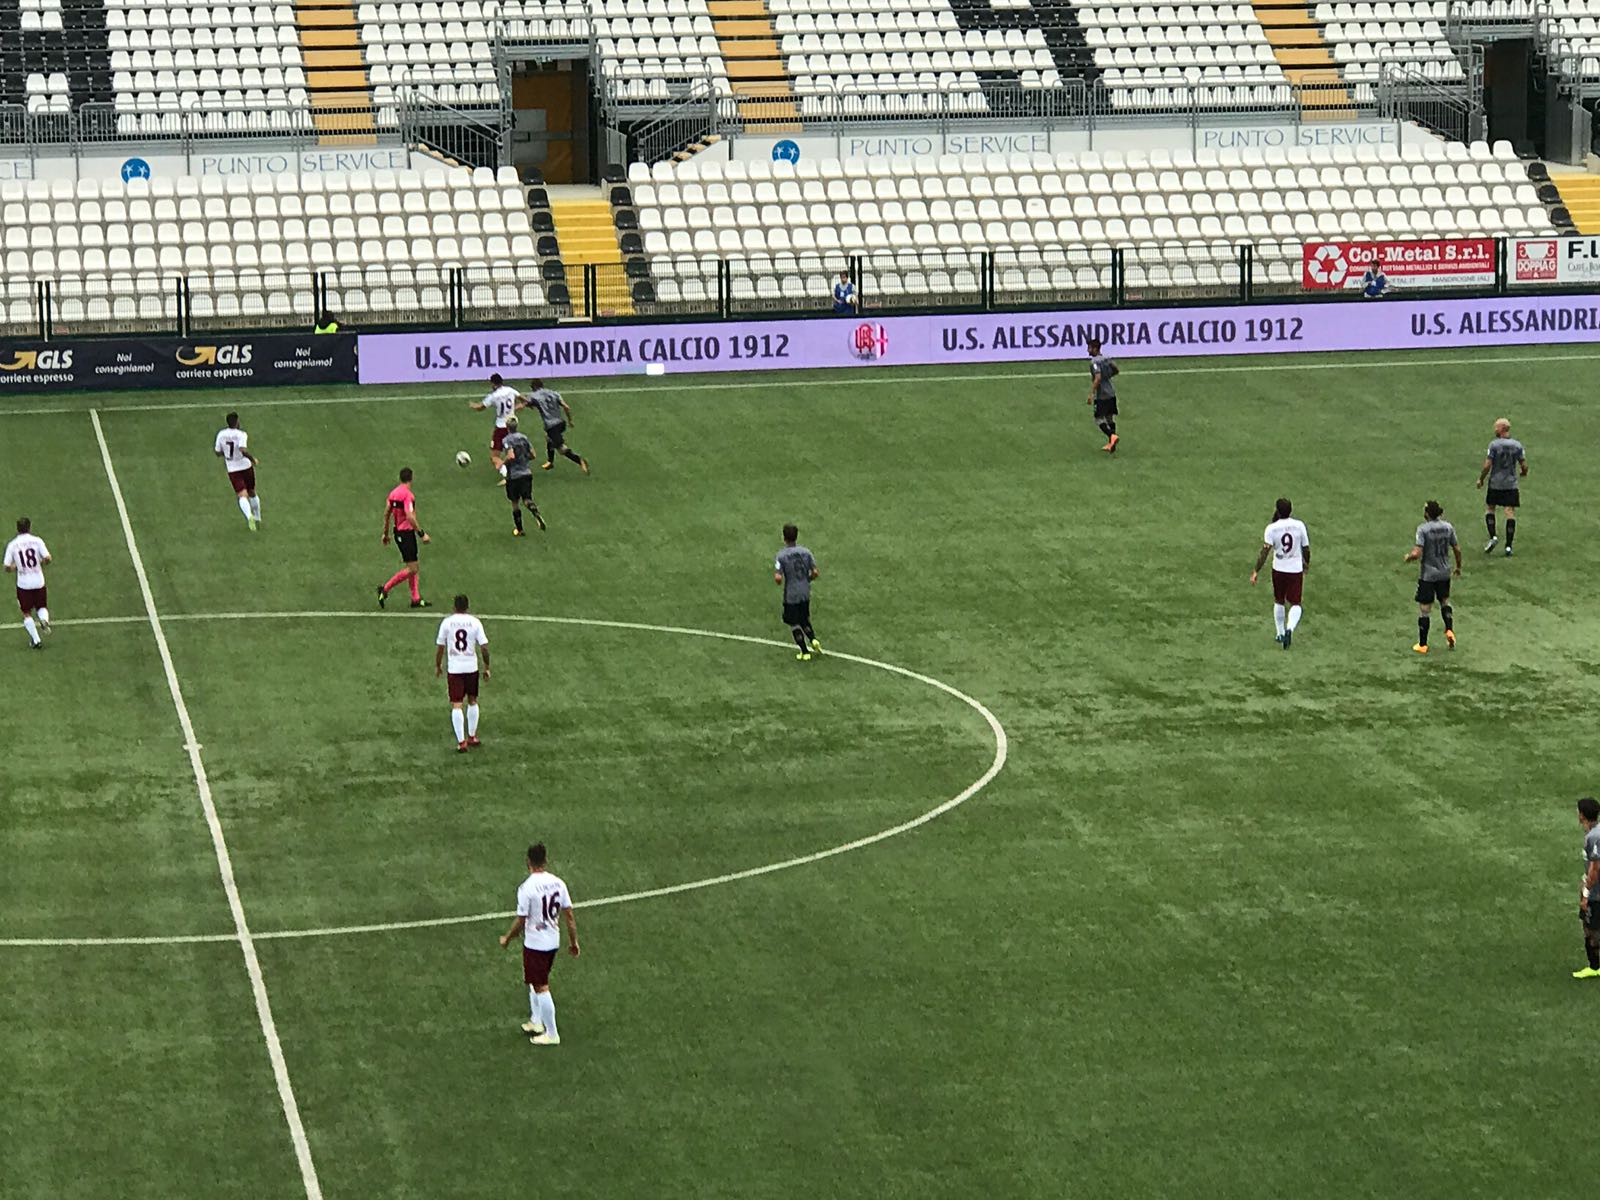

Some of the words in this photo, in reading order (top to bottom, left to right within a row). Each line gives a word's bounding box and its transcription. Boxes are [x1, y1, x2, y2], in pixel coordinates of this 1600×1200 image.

[851, 137, 933, 157] PUNTO
[946, 134, 1047, 154] SERVICE
[1204, 128, 1285, 148] PUNTO
[1300, 125, 1395, 146] SERVICE
[203, 155, 288, 175] PUNTO
[303, 151, 404, 172] SERVICE
[1349, 245, 1441, 263] Col-Metal
[1445, 244, 1490, 261] S.r.l.
[1411, 313, 1452, 336] U.S.
[1459, 307, 1600, 334] ALESSANDRI
[942, 327, 985, 351] U.S.
[992, 320, 1152, 351] ALESSANDRIA
[1157, 319, 1236, 345] CALCIO
[1244, 316, 1304, 342] 1912
[37, 350, 73, 369] GLS
[116, 352, 132, 362] Noi
[216, 344, 252, 364] GLS
[295, 347, 311, 357] Noi
[414, 345, 459, 370] U.S.
[467, 338, 633, 369] ALESSANDRIA
[639, 336, 720, 363] CALCIO
[727, 333, 790, 360] 1912
[95, 362, 155, 376] consegniamo!
[176, 367, 212, 379] corriere
[213, 367, 253, 380] espresso
[273, 357, 333, 370] consegniamo!
[0, 373, 31, 384] orriere
[33, 373, 74, 385] espresso
[225, 441, 235, 458] 7
[1281, 532, 1294, 554] 9
[18, 547, 38, 569] 18
[455, 628, 468, 652] 8
[541, 890, 561, 921] 16
